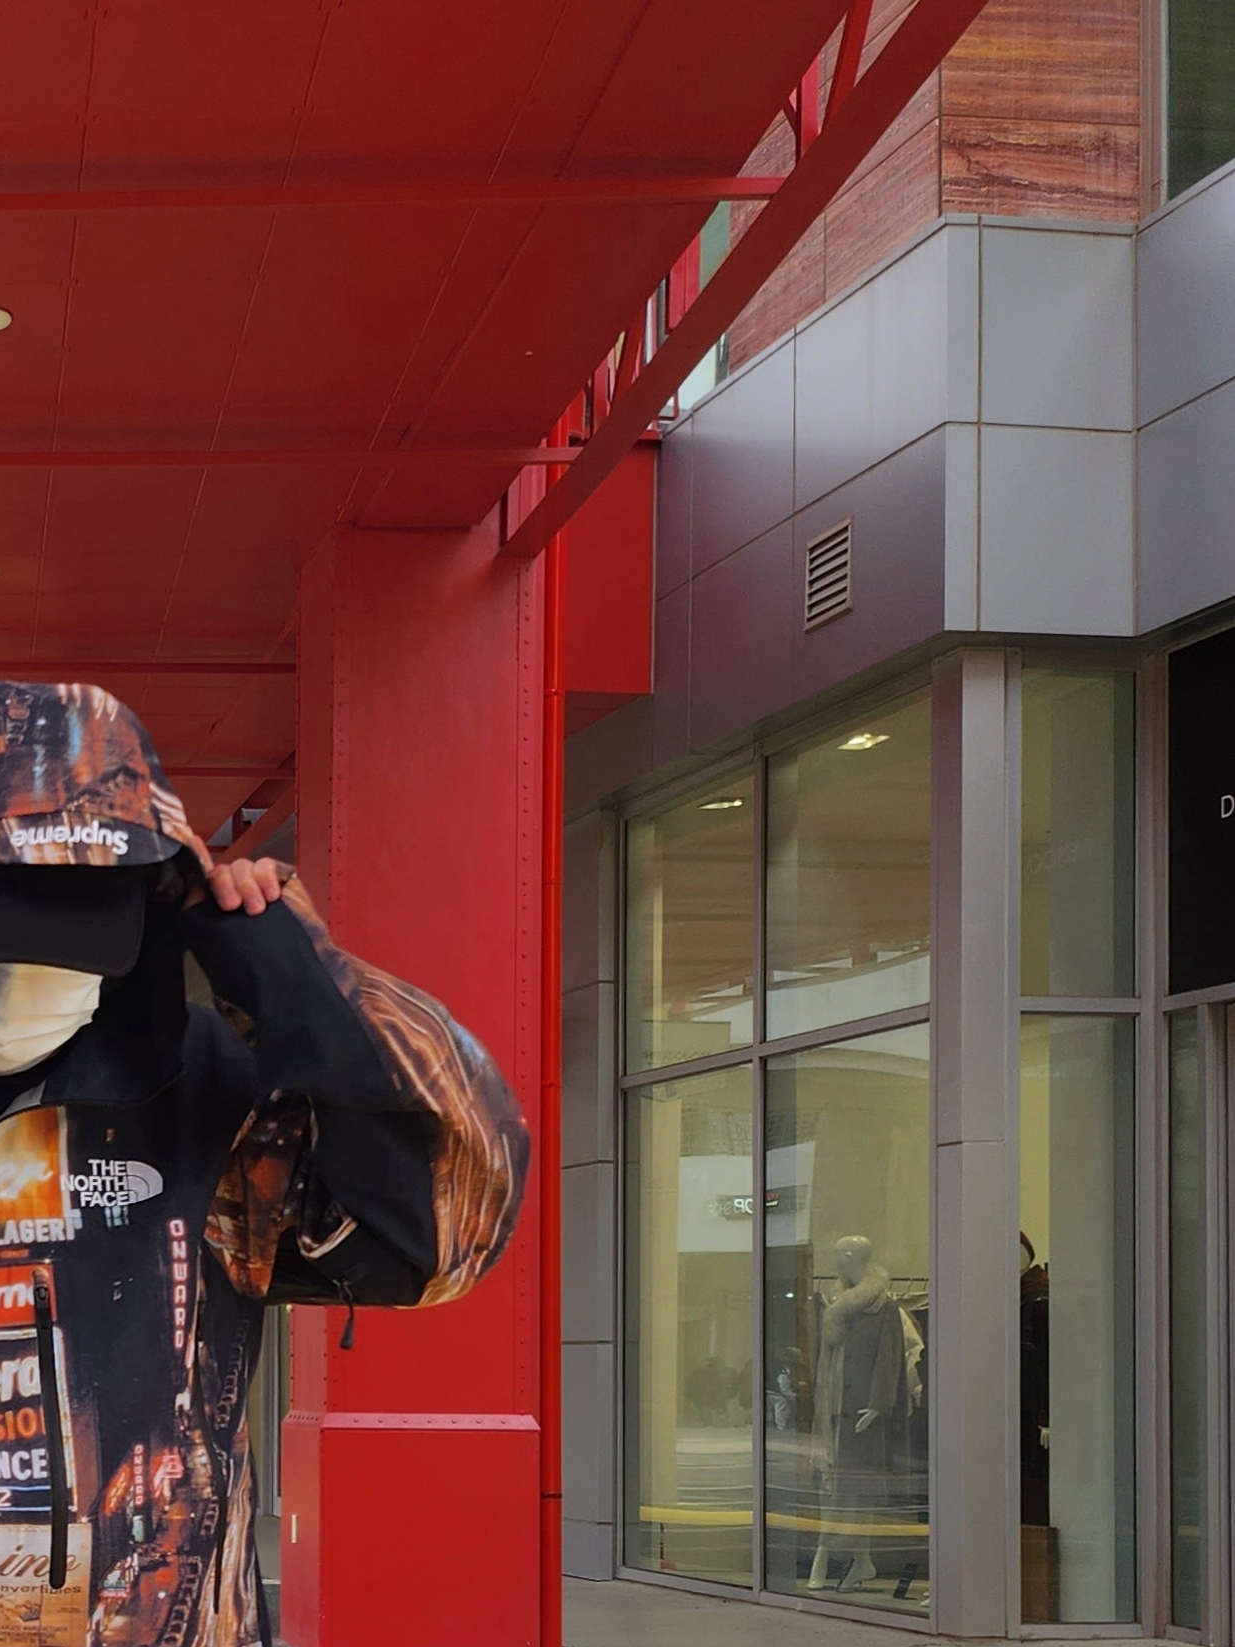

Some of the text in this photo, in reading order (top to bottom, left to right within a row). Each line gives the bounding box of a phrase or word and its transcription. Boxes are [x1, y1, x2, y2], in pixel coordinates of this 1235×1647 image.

[10, 821, 129, 856] Supreme
[88, 1159, 127, 1176] THE
[60, 1174, 128, 1192] NORTH
[80, 1191, 129, 1208] FACE
[169, 1219, 188, 1349] ONWARD
